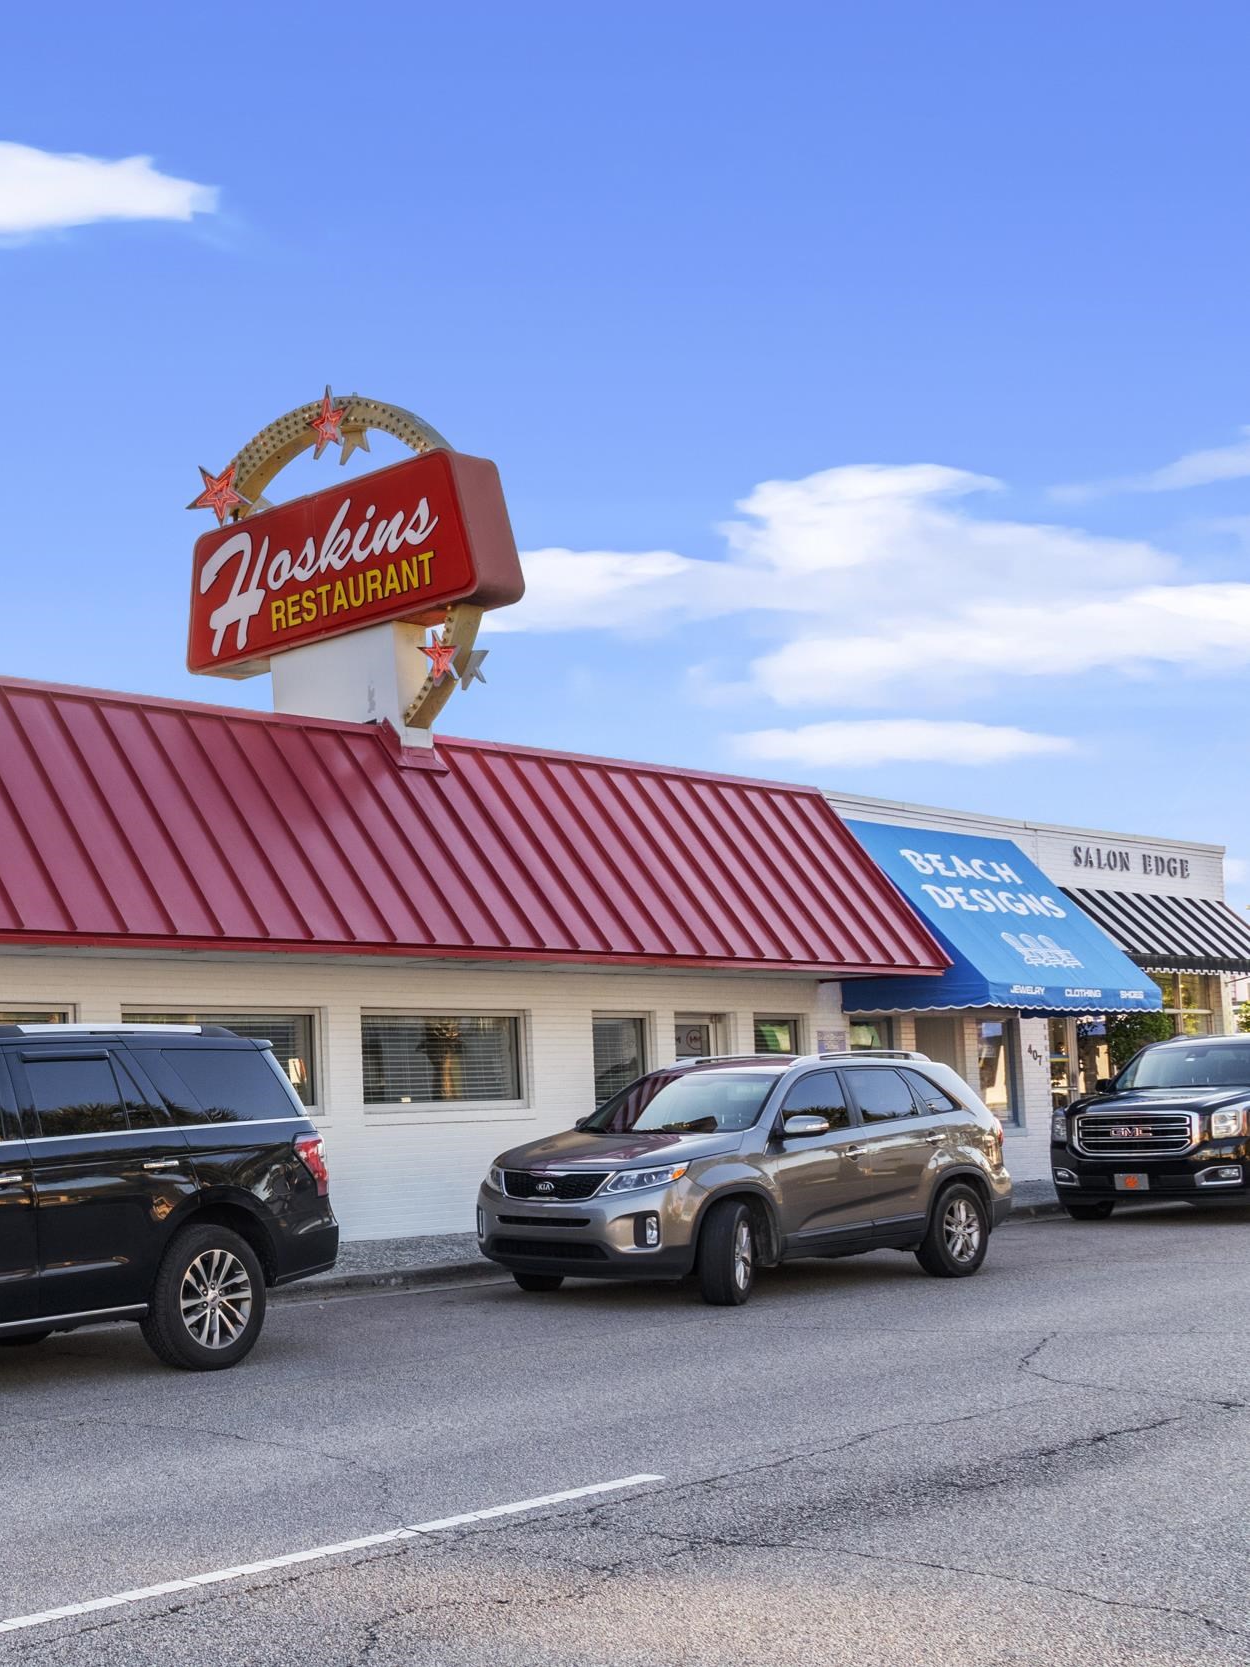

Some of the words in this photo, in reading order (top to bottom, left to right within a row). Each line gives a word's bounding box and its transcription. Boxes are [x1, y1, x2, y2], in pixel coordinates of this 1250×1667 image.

[200, 497, 439, 657] Hoskins
[270, 551, 435, 632] RESTAURANT
[900, 849, 1023, 885] BEACH
[1073, 845, 1130, 872] SALON
[1142, 854, 1191, 879] EDGE
[921, 884, 1067, 919] DESIGNS
[1010, 985, 1045, 995] JEWELRY
[1065, 989, 1102, 998] CLOTHING
[1120, 990, 1144, 999] SHOES
[1027, 1044, 1042, 1066] 407
[1110, 1127, 1153, 1137] GMC
